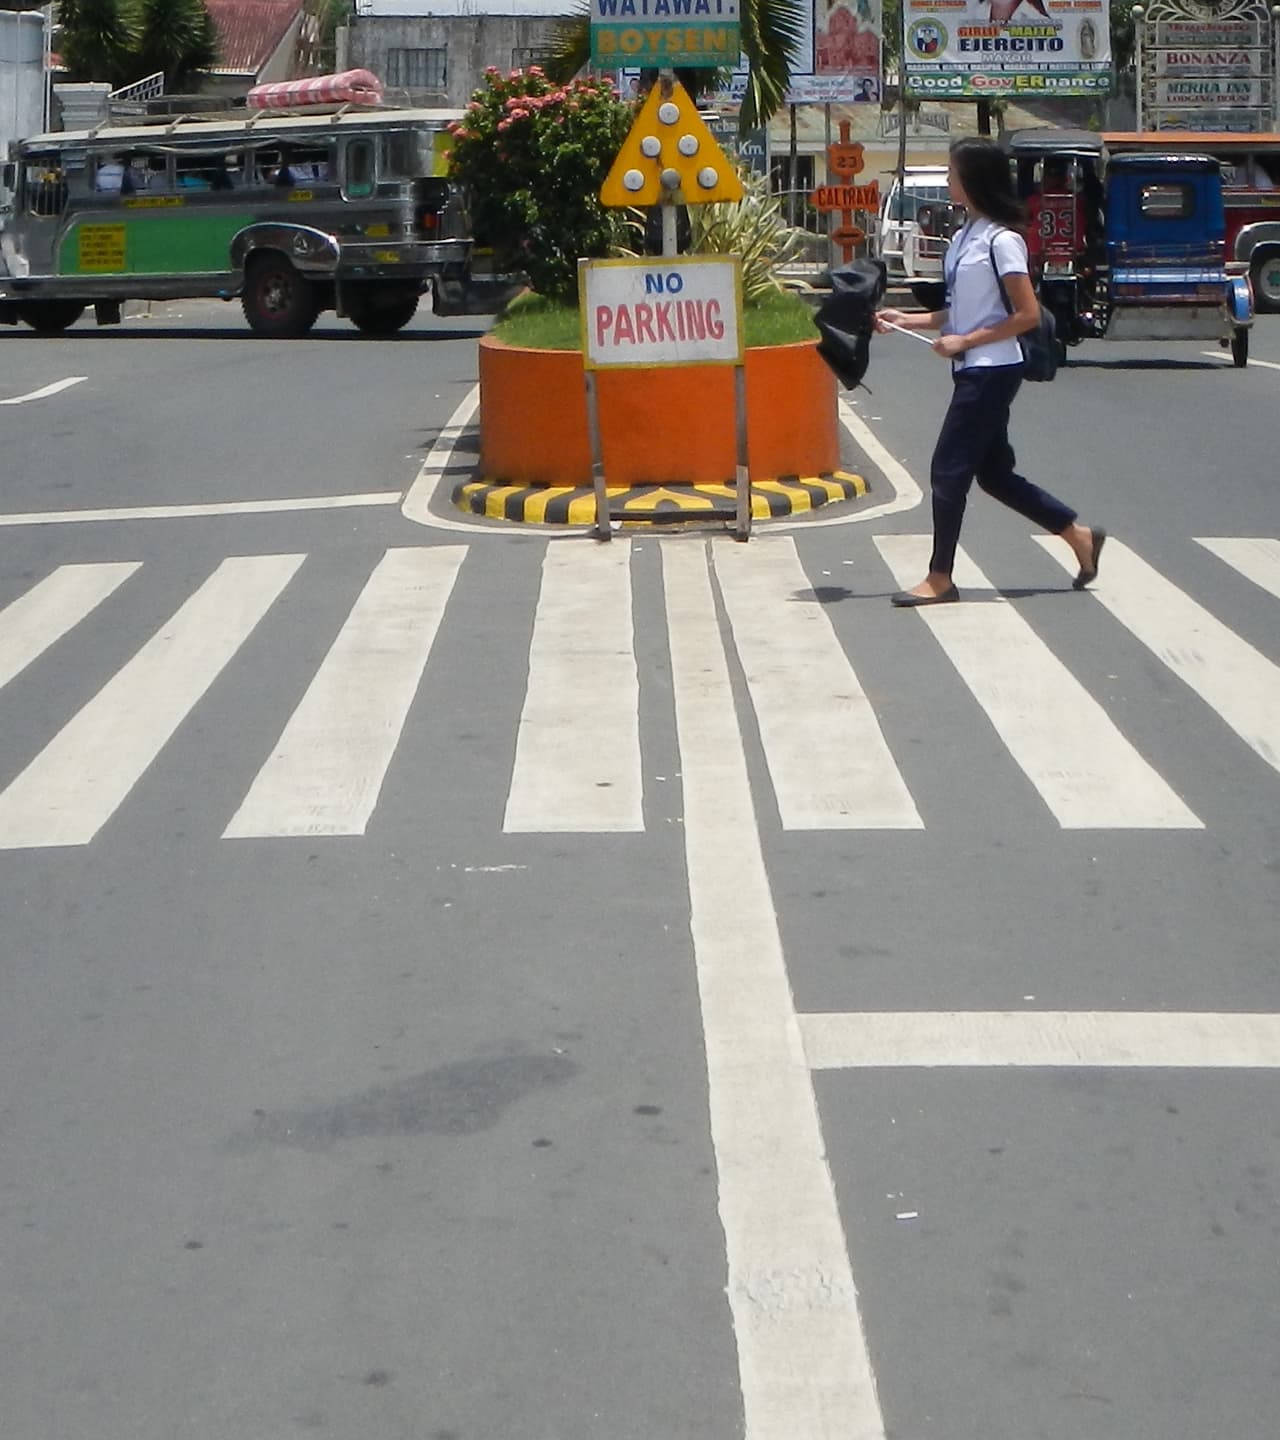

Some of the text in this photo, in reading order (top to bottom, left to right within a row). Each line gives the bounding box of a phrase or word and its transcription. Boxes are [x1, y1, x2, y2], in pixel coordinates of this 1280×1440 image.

[597, 27, 727, 54] BOYSEN
[959, 37, 1064, 52] EJERCITO
[1166, 52, 1251, 65] BONANZA
[907, 73, 1110, 89] Good GovERnance
[644, 272, 683, 294] NO
[595, 297, 725, 348] PARKING
